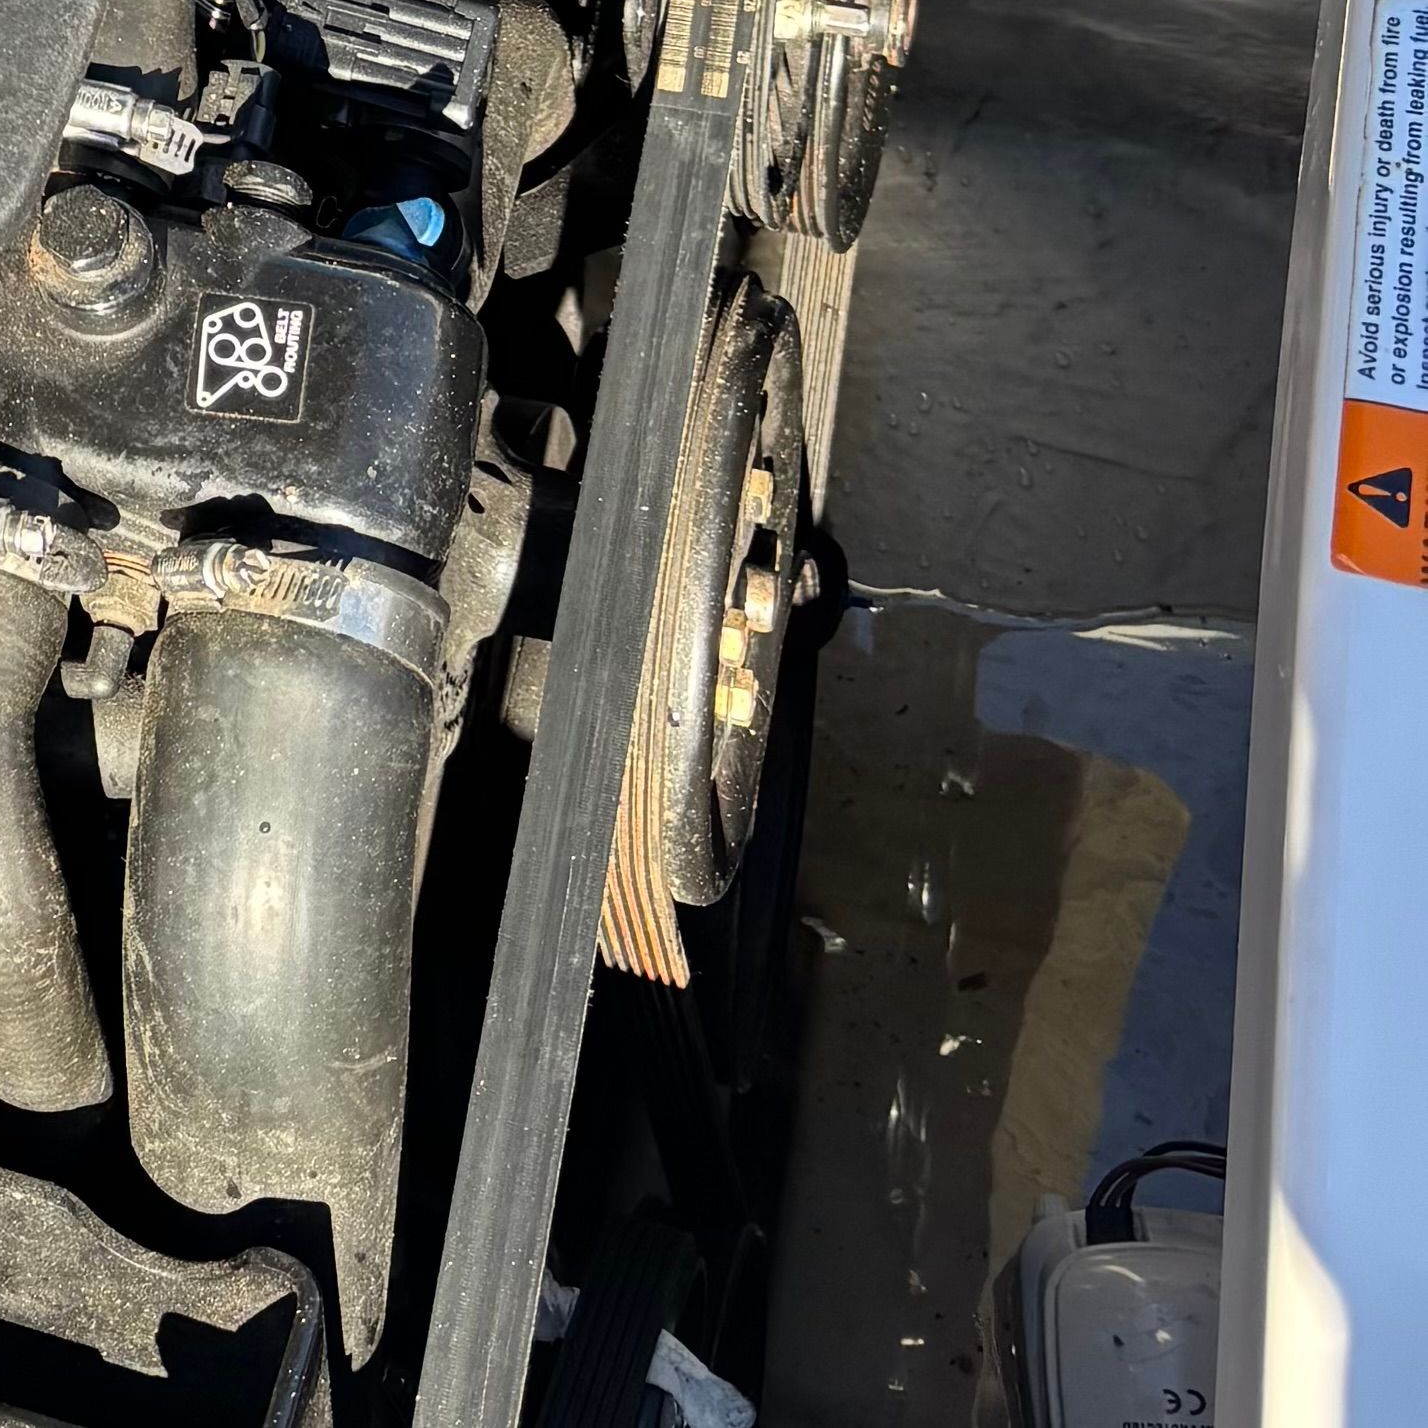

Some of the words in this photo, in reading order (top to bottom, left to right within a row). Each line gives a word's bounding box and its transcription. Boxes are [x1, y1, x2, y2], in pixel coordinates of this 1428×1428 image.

[1381, 16, 1401, 46] fire
[1378, 51, 1399, 94] from
[1405, 48, 1428, 116] leaking
[1374, 100, 1395, 152] death
[1402, 121, 1424, 165] from
[1376, 158, 1391, 177] or
[1367, 182, 1395, 237] injury
[1398, 167, 1425, 256] resulting
[1364, 243, 1385, 316] serious
[274, 307, 290, 344] BELT
[1391, 260, 1414, 359] explosion
[283, 309, 304, 373] ROUTING
[1357, 321, 1379, 380] Avoid
[1391, 363, 1406, 385] or
[1163, 1389, 1207, 1416] CE
